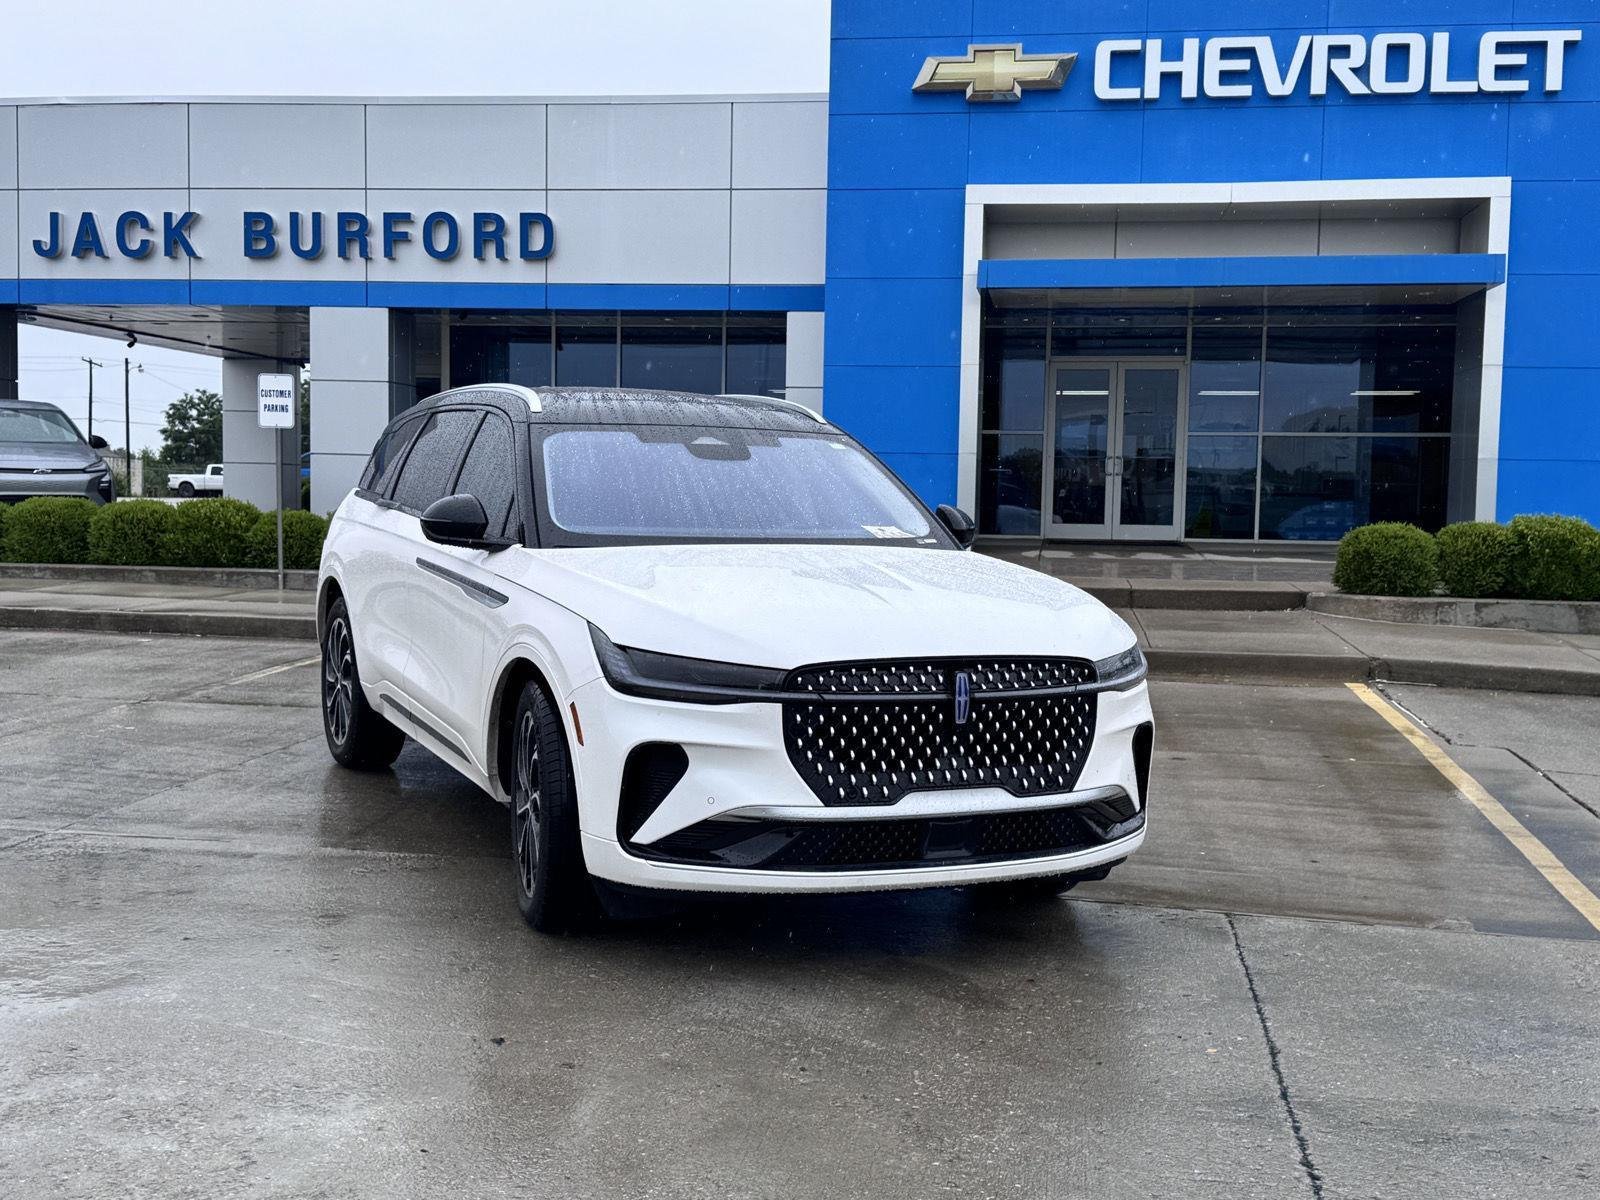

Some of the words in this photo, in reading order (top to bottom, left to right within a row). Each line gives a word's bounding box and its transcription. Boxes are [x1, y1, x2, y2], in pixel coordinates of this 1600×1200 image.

[1094, 30, 1582, 100] CHEVROLET
[33, 211, 202, 259] JACK
[243, 211, 556, 261] BURFORD
[260, 389, 292, 398] CUSTOMER
[263, 403, 289, 413] PARKING
